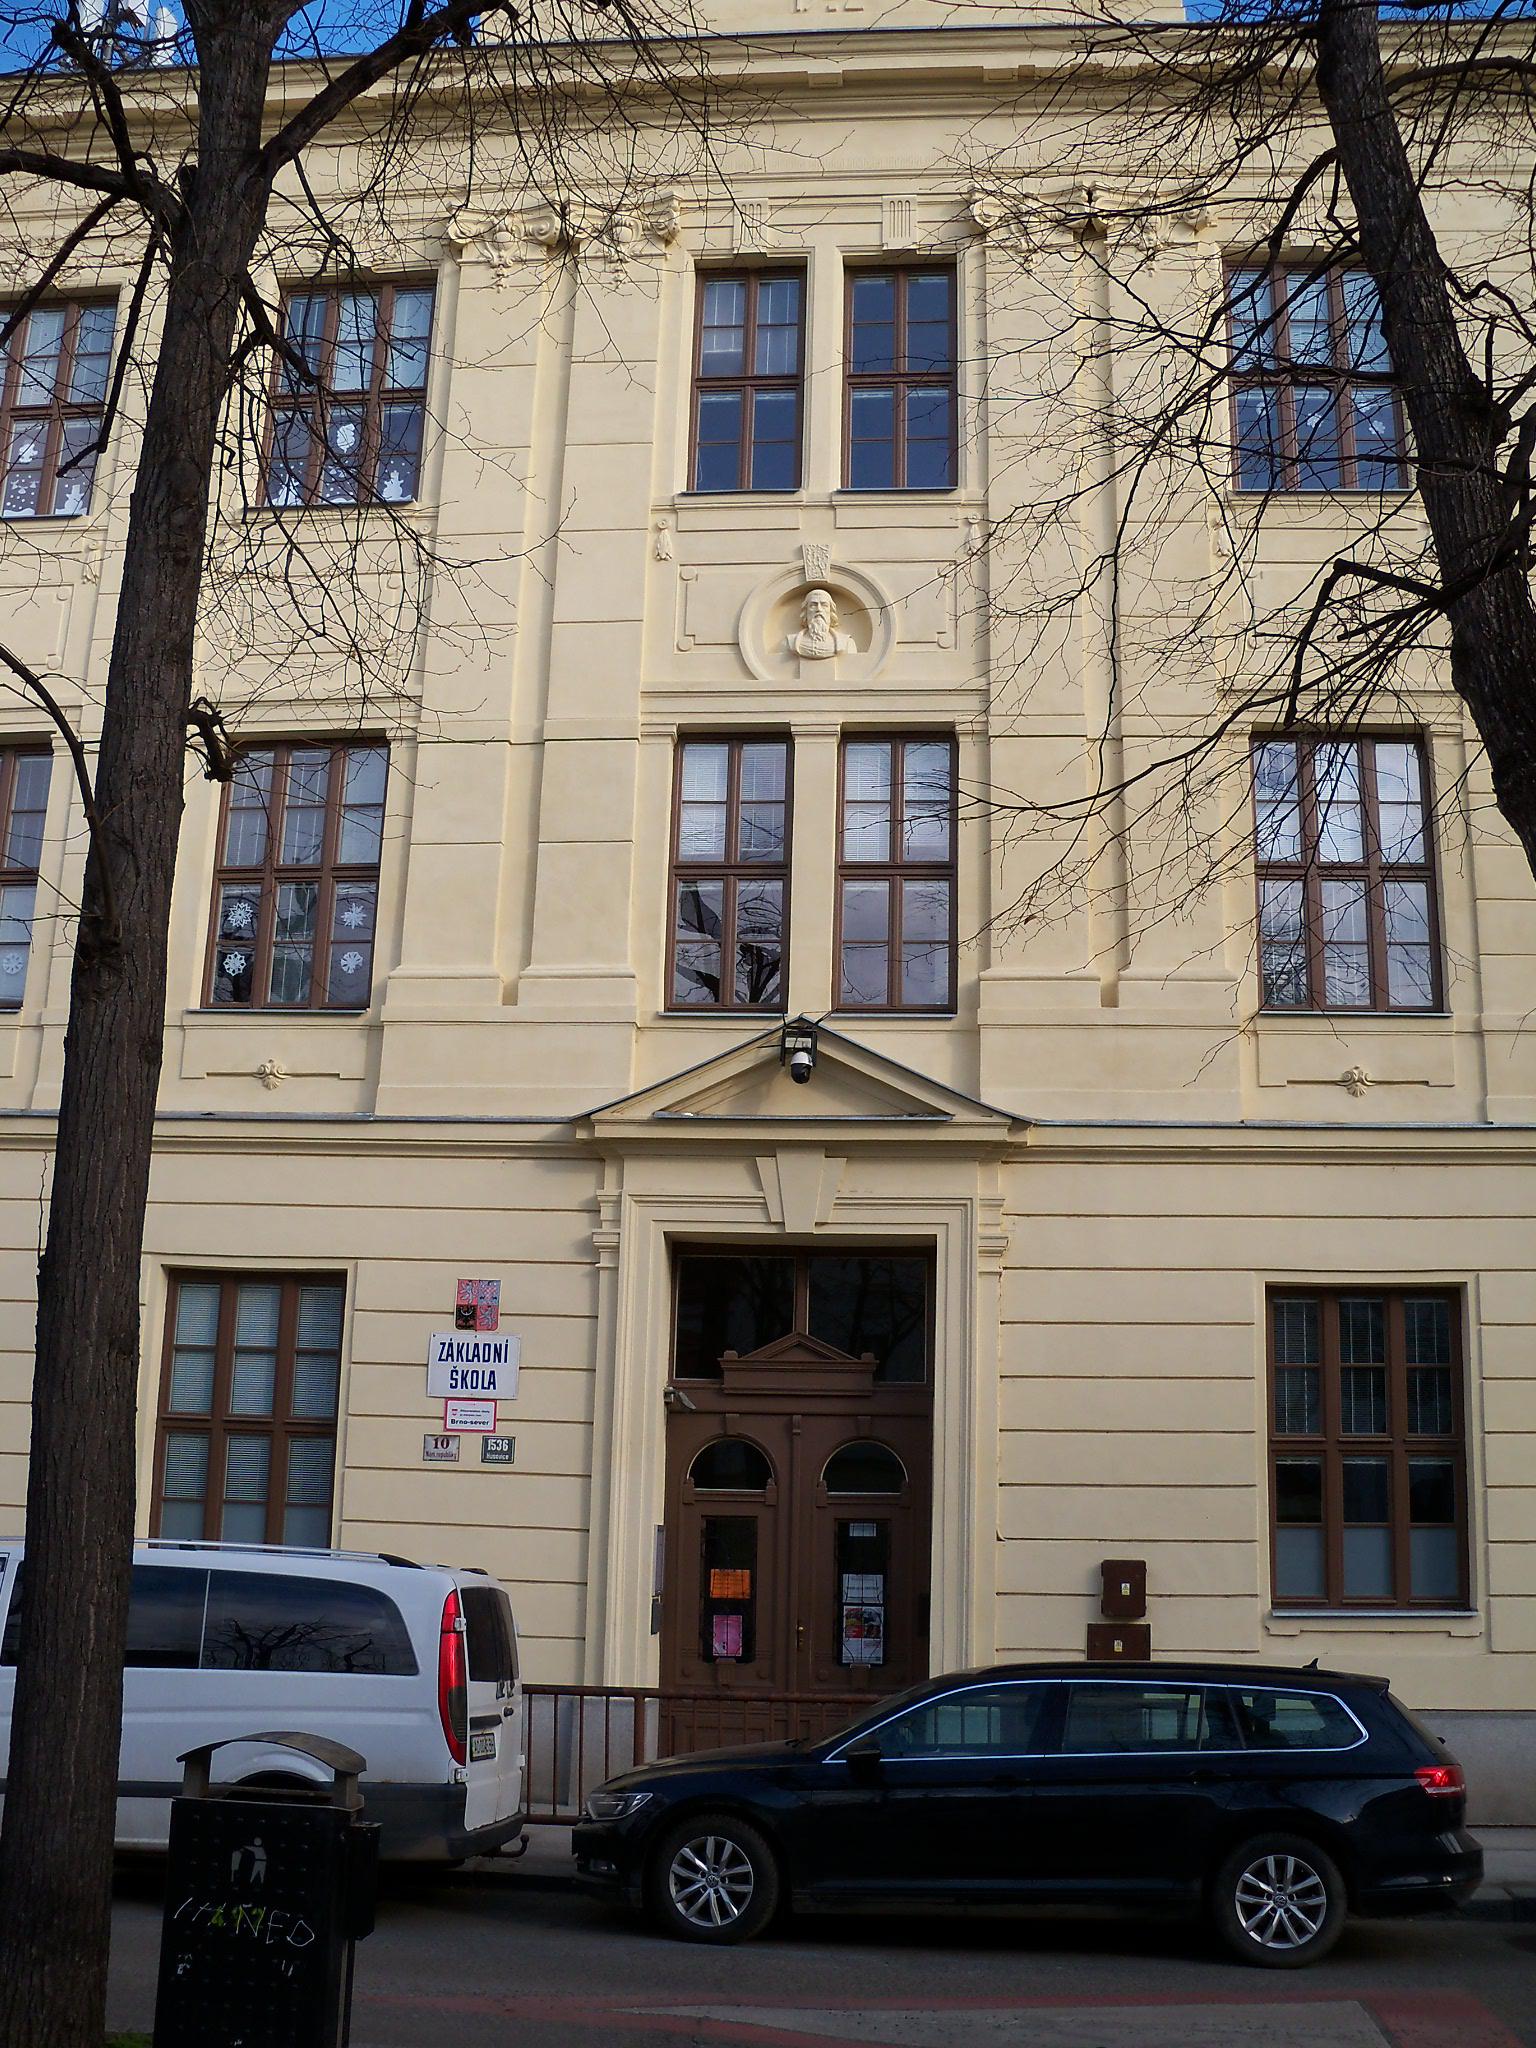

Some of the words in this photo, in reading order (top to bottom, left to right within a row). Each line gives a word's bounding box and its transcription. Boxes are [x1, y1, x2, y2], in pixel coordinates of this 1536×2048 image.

[438, 1338, 509, 1364] ZÁKLADNÍ
[449, 1366, 497, 1391] ŠKOLA
[433, 1437, 450, 1449] 10
[487, 1439, 509, 1451] 1536
